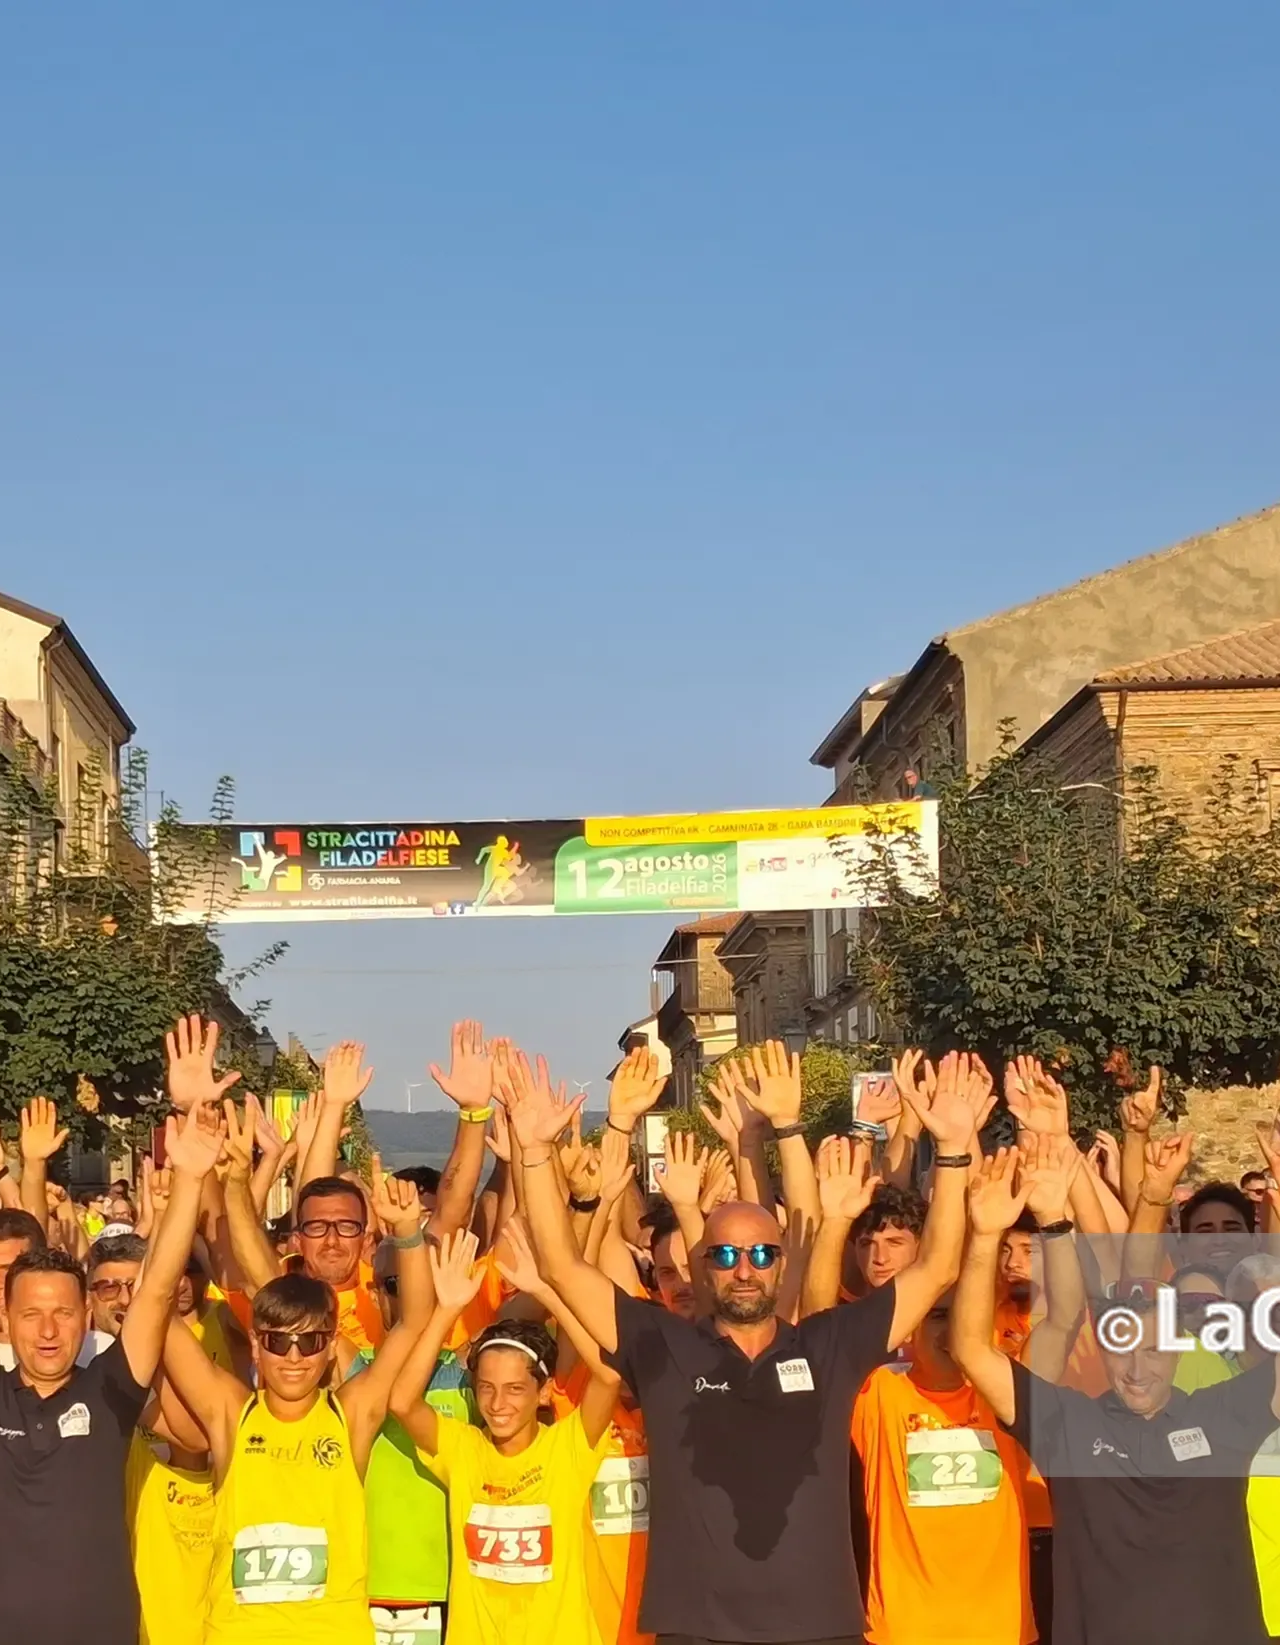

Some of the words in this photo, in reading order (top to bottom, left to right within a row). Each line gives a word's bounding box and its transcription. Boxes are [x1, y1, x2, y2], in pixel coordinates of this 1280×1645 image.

[306, 830, 461, 849] STRACITTADINA
[599, 827, 621, 838] NON
[622, 825, 686, 838] COMPETITIVA
[708, 821, 765, 834] CAMMINATA
[319, 849, 450, 867] FILADELFIESE
[712, 852, 728, 893] 2026
[567, 858, 626, 899] 12
[624, 852, 710, 877] agosto
[626, 875, 709, 896] Filadelfia
[931, 1453, 978, 1485] 22
[603, 1481, 648, 1514] 10
[477, 1528, 542, 1561] 733
[244, 1547, 313, 1581] 179
